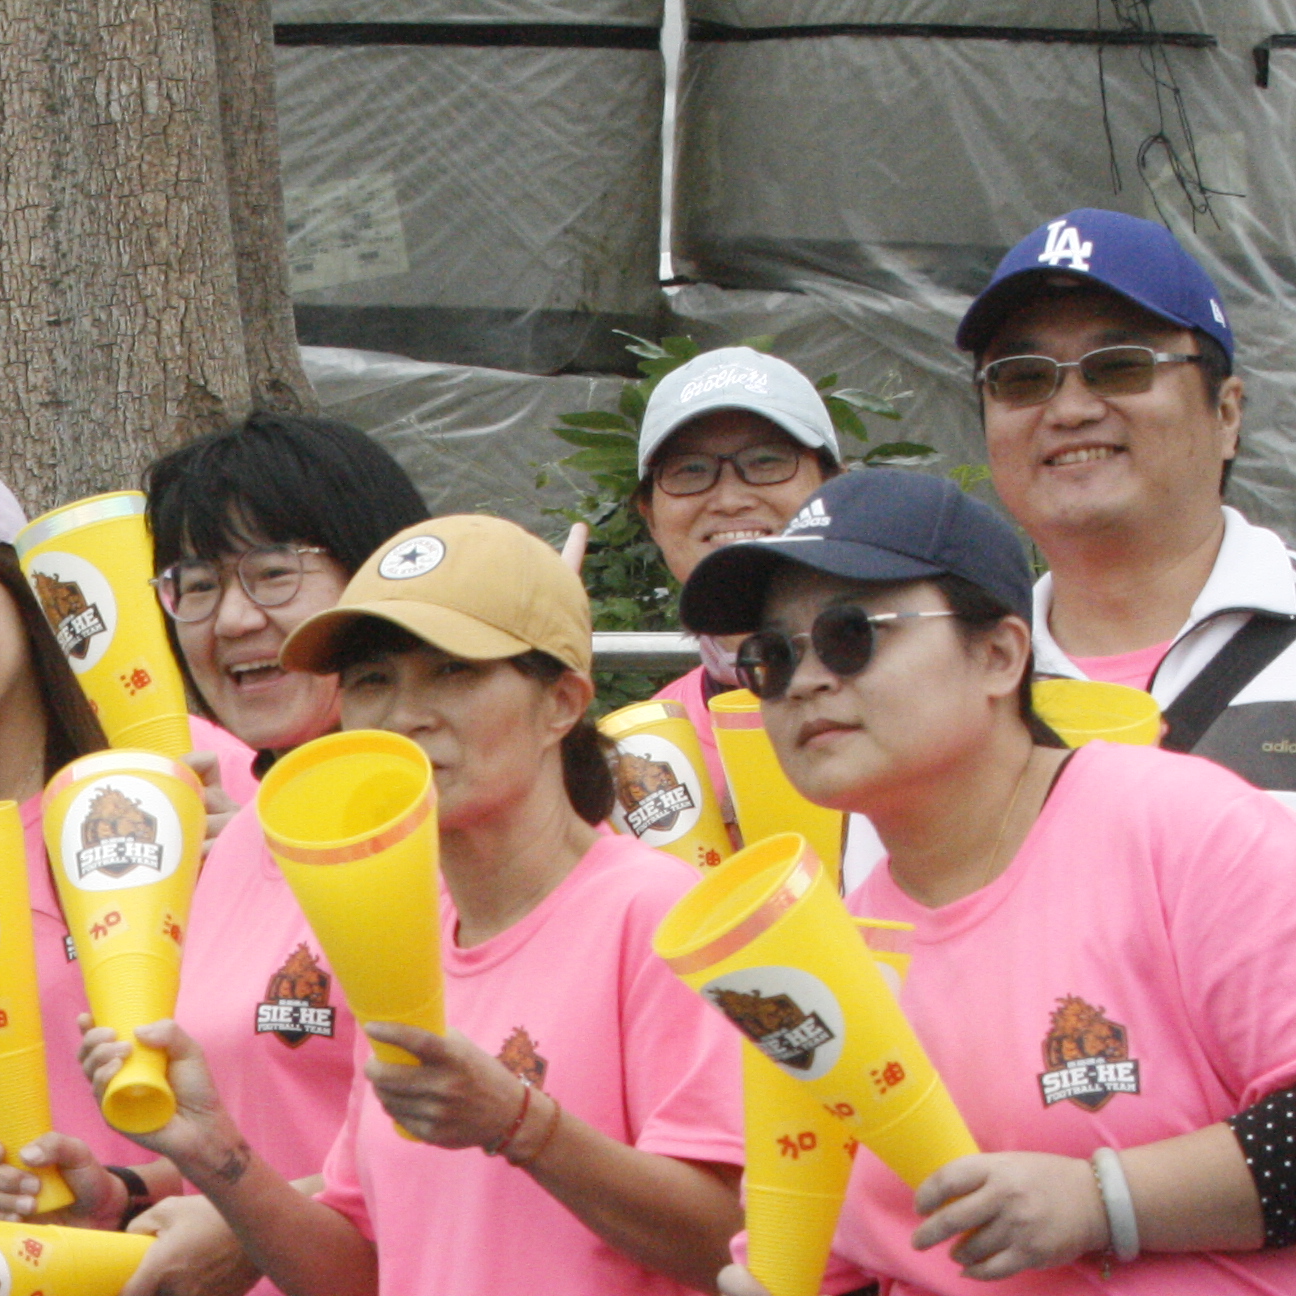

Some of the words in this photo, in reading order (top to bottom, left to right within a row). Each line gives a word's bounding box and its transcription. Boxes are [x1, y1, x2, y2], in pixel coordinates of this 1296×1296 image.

[1038, 220, 1093, 272] LA
[628, 786, 689, 829] SIE-HE
[79, 841, 159, 866] SIE-HE
[258, 1004, 332, 1027] SIE-HE
[870, 1061, 905, 1094] 油
[1042, 1062, 1135, 1094] SIE-HE
[1046, 1083, 1103, 1104] FOOTBALL
[1105, 1082, 1137, 1092] TEAM
[18, 1238, 43, 1267] 油
